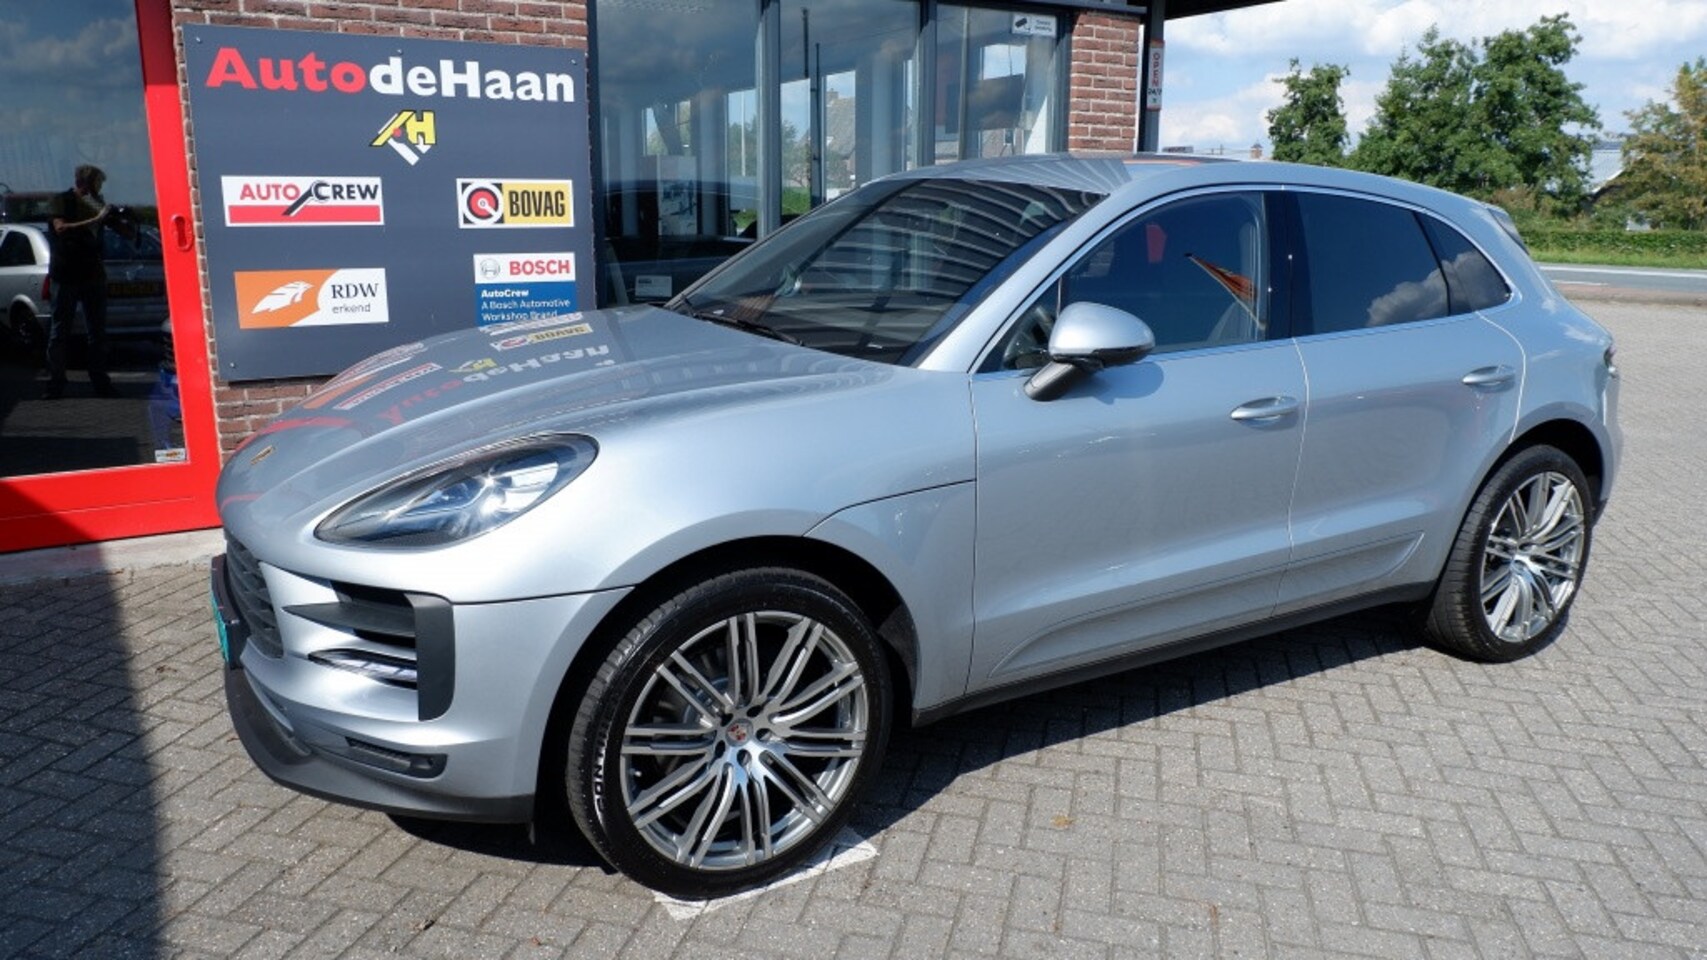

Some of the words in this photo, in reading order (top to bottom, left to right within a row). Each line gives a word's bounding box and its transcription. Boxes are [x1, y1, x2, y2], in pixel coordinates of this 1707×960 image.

[1152, 52, 1161, 87] OPEN
[239, 182, 301, 201] AUTO
[313, 180, 379, 202] CREW
[508, 189, 566, 218] BOVAG
[509, 259, 571, 277] BOSCH
[330, 281, 379, 299] RDW
[481, 288, 530, 299] AutoCrew
[331, 301, 372, 314] erkend
[481, 301, 489, 310] A
[490, 299, 518, 310] Bosch
[520, 298, 572, 309] Automotive
[481, 311, 529, 322] Workshop
[530, 309, 558, 320] Brand
